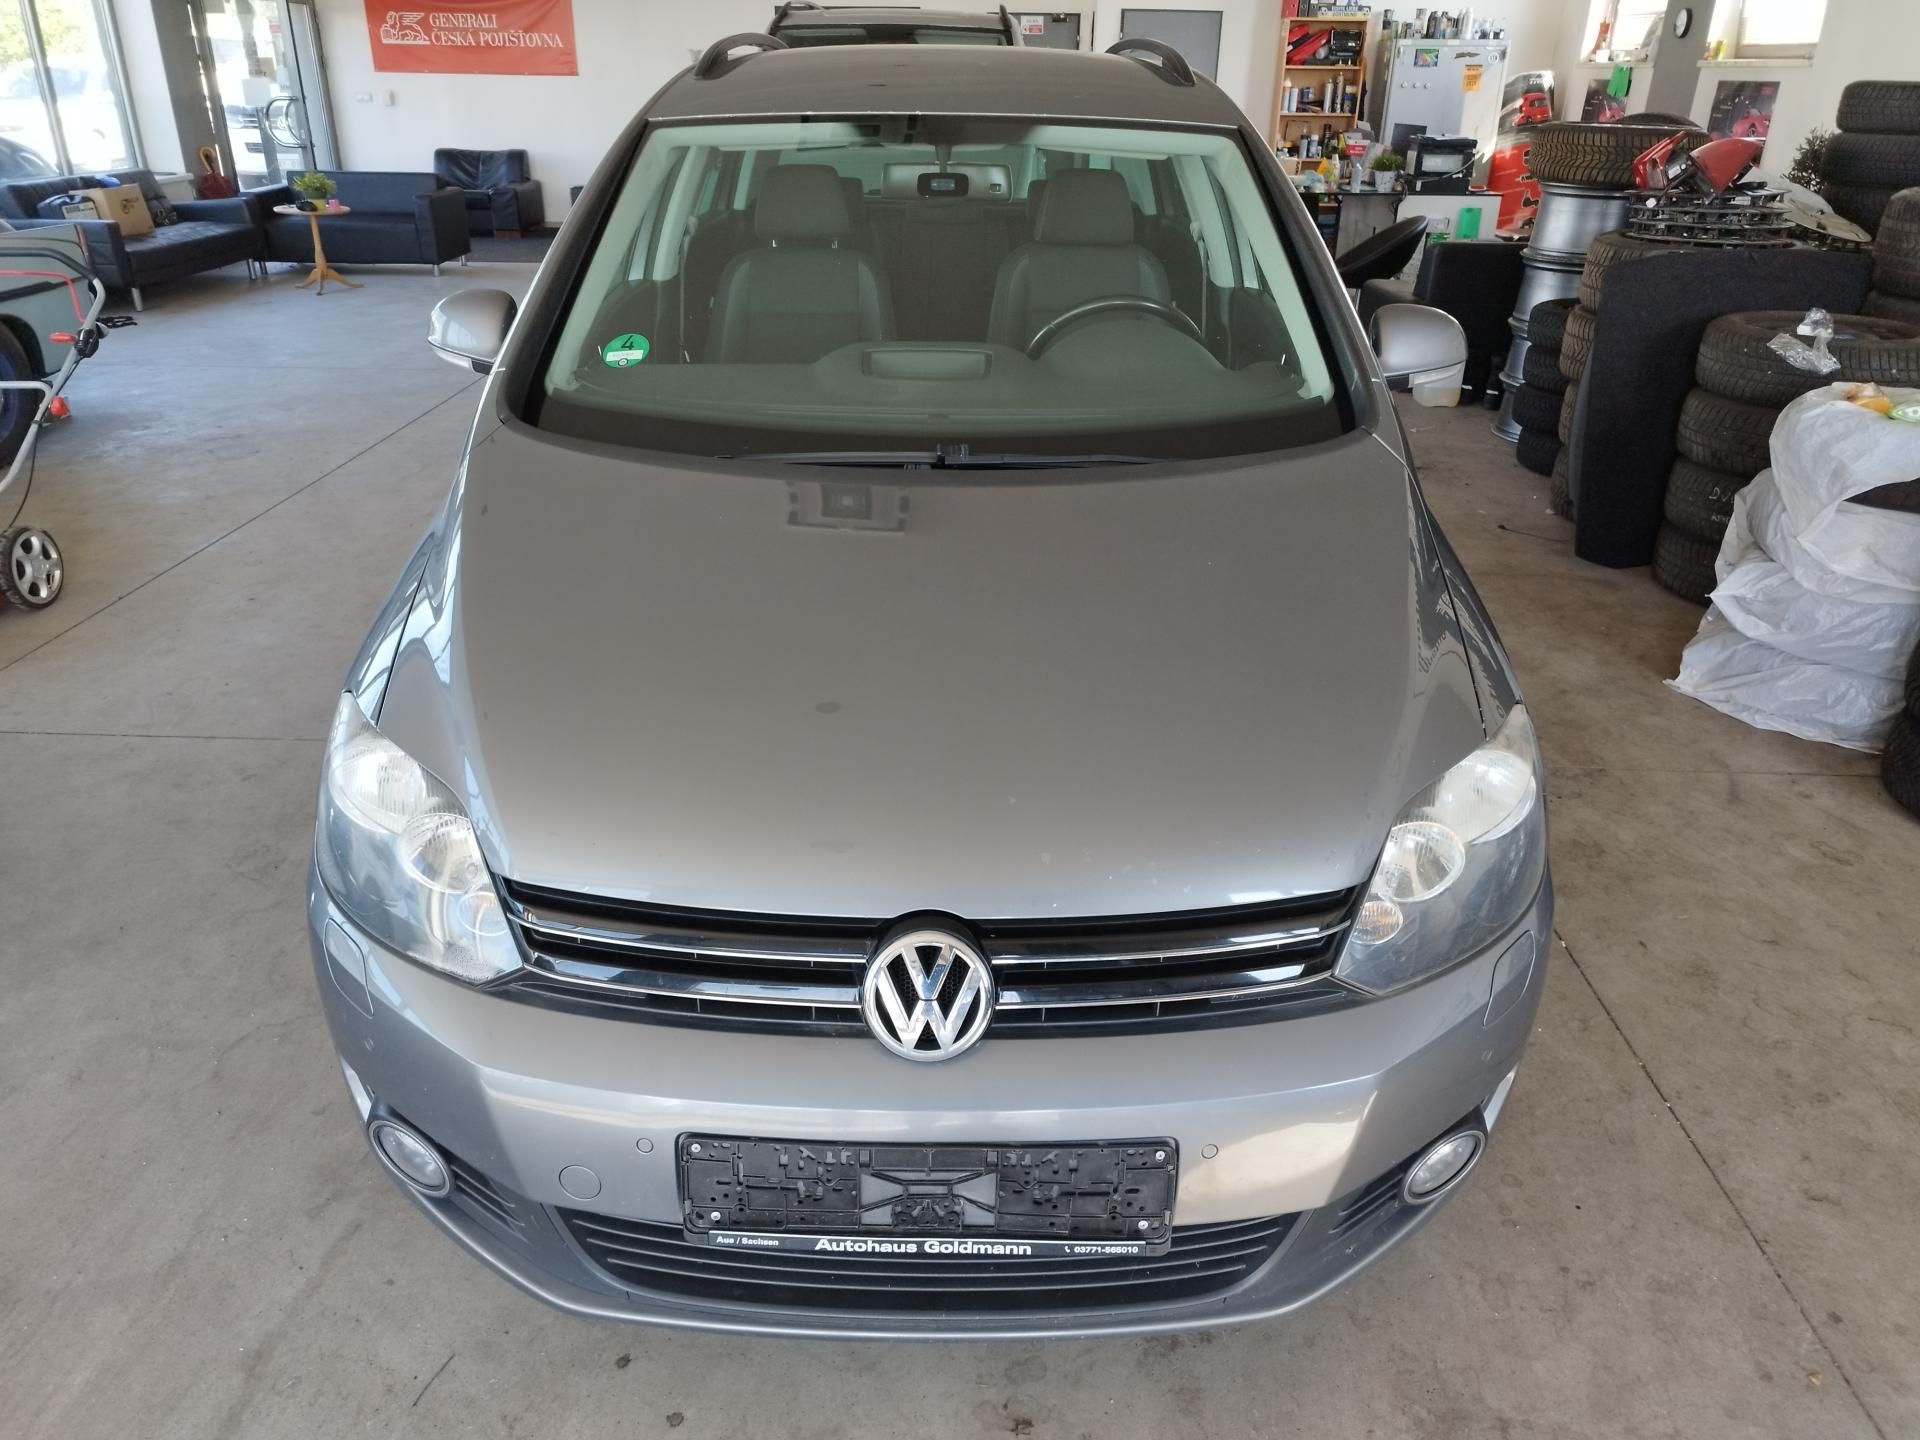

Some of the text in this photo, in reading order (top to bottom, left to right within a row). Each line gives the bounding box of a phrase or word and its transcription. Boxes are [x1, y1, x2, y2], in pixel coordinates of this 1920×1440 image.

[428, 12, 497, 28] GENERALI
[431, 28, 564, 48] ČESKÁ POJIŠŤOVNA
[621, 335, 635, 350] 4
[716, 1235, 735, 1244] Aue
[741, 1236, 779, 1246] Sachsen
[814, 1238, 1032, 1255] Autohaus Goldmann
[1073, 1245, 1139, 1254] 03771-565010
